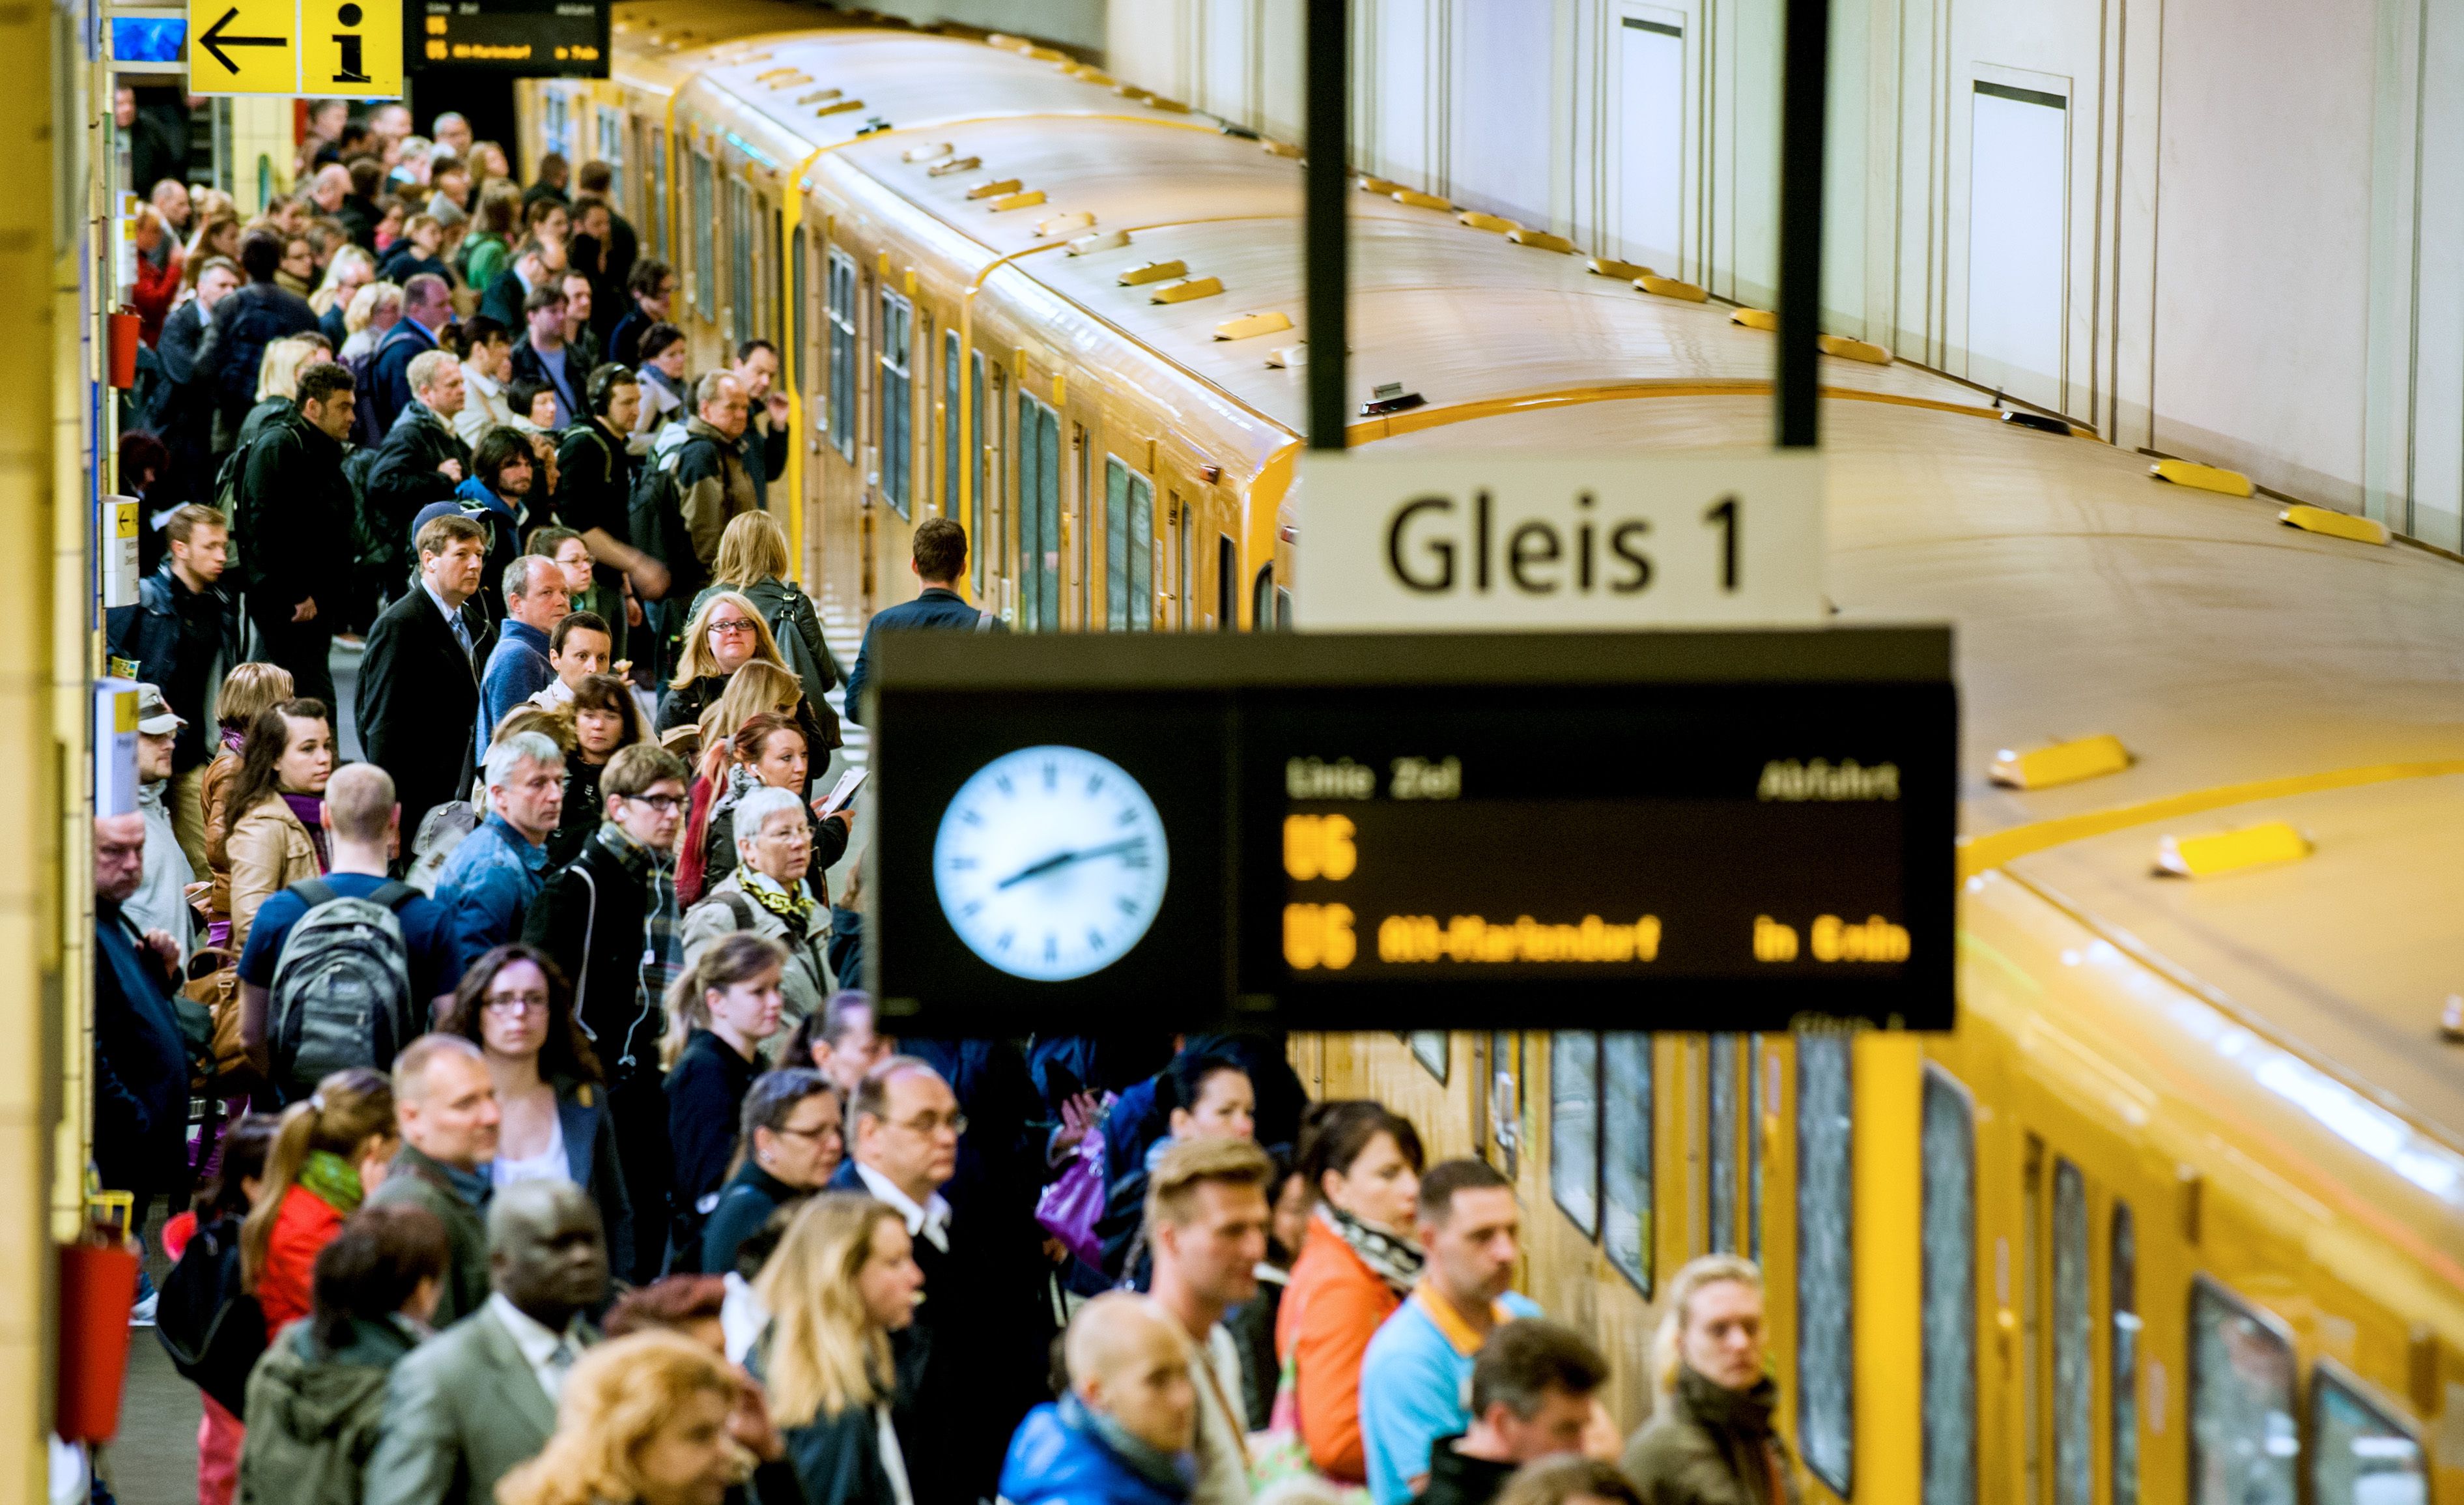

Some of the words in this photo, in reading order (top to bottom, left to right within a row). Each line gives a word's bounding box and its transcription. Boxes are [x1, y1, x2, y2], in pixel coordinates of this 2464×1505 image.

[1385, 488, 1654, 594] Gleis
[1702, 493, 1739, 594] 1
[1286, 756, 1375, 799] Linie
[1390, 755, 1462, 799] Ziel
[1757, 756, 1901, 801] Abfahrt
[1283, 814, 1356, 880] U6
[1283, 903, 1356, 969] U6
[1378, 914, 1661, 962] Alt-Mariendorf
[1753, 914, 1798, 962] in
